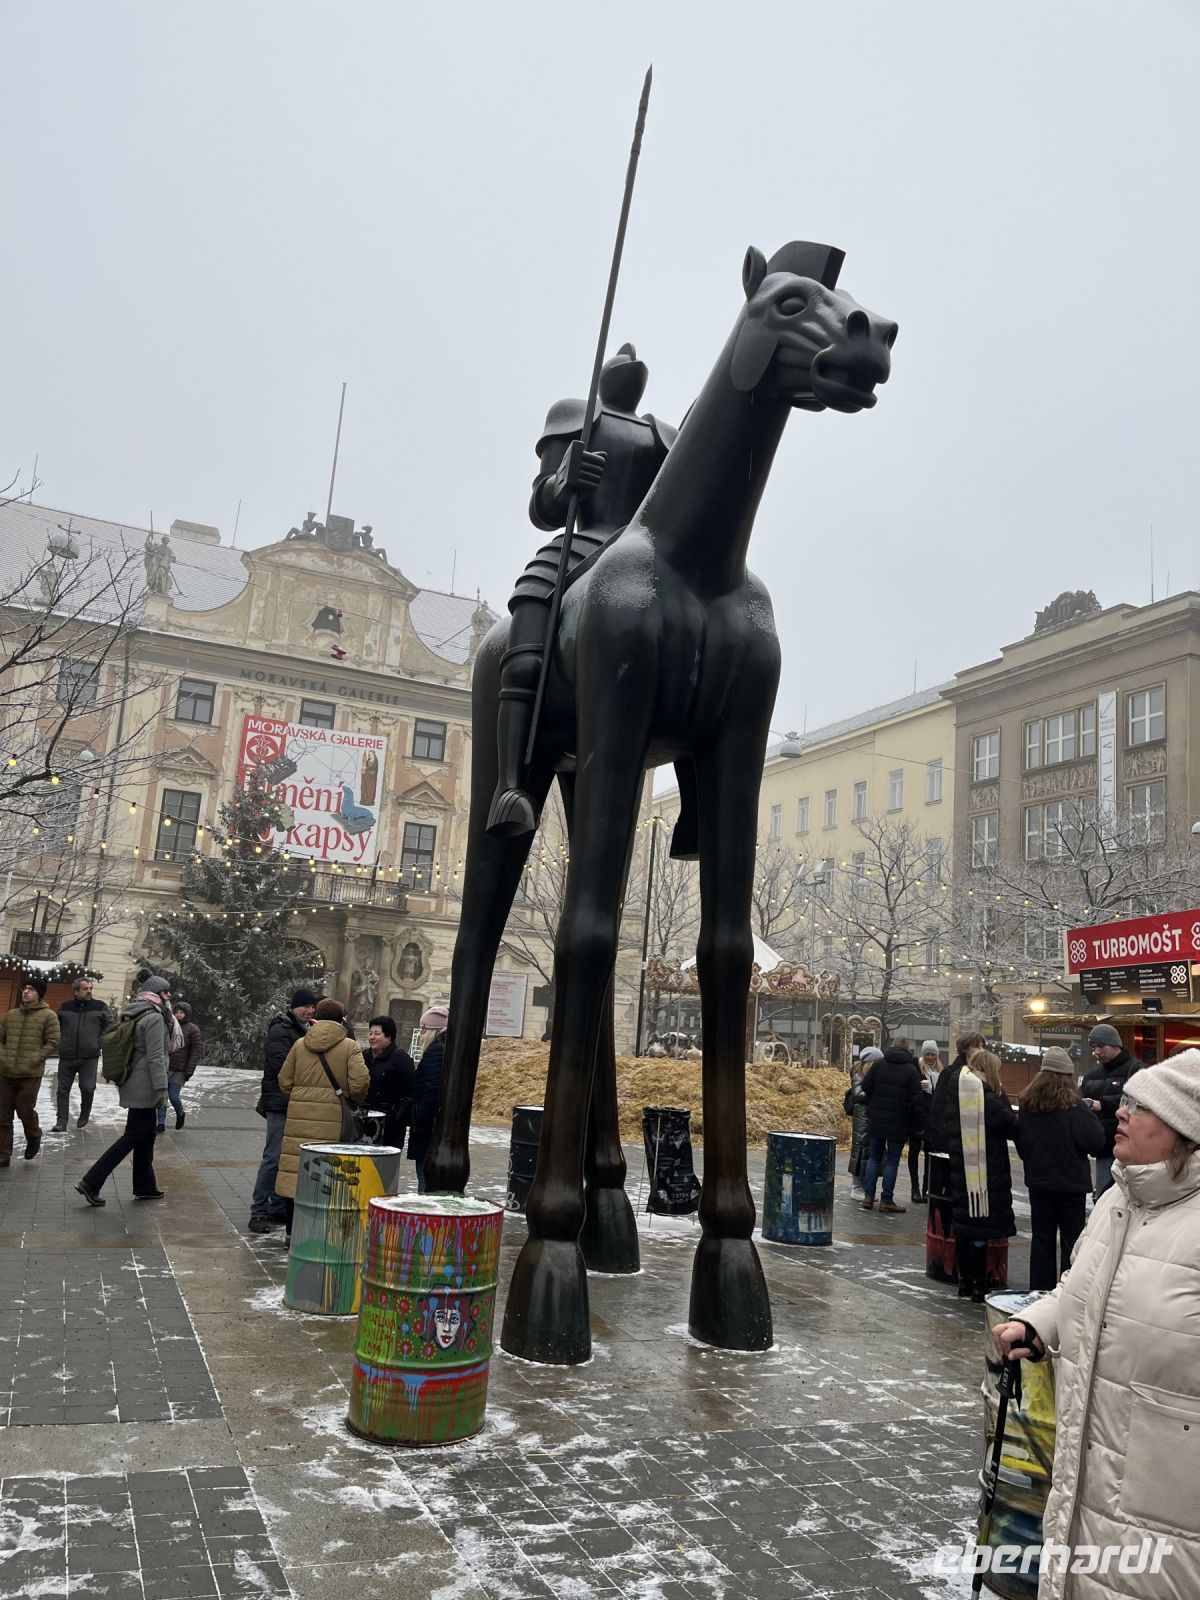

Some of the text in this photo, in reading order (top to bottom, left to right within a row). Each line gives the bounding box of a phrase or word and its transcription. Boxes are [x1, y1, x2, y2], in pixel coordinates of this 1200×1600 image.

[240, 669, 400, 705] MORAVSKÁ GALERIE
[248, 719, 384, 750] MORAVSKÁ GALERIE
[1092, 923, 1182, 960] TURBOMOŠT
[1002, 1367, 1010, 1388] LEKI
[987, 1459, 998, 1500] LEKI
